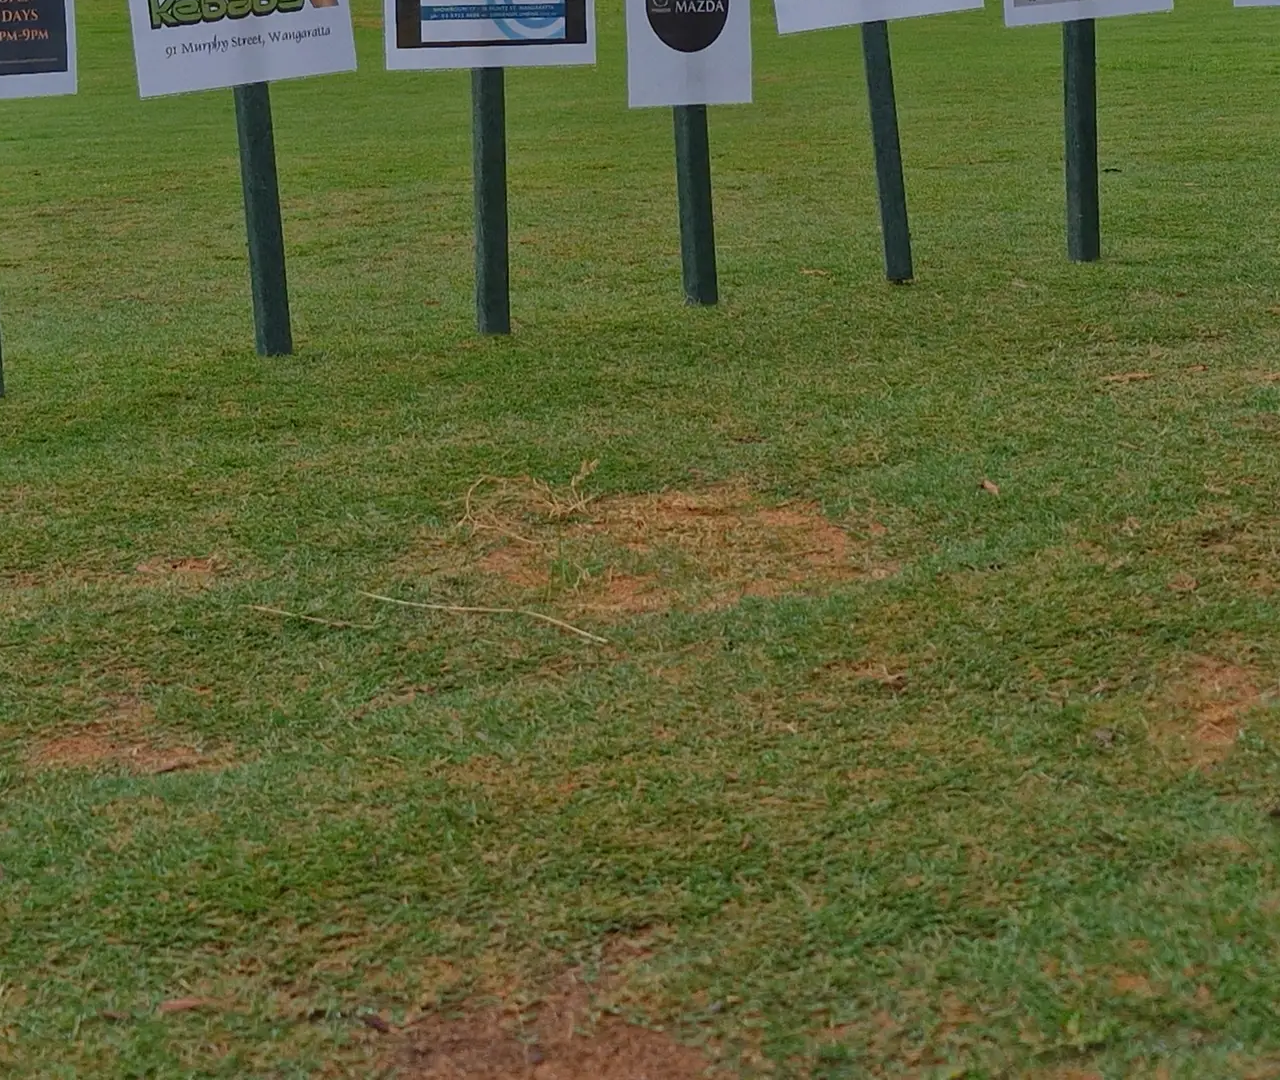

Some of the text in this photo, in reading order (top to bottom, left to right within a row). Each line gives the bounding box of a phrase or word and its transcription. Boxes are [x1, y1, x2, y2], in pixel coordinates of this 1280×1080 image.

[675, 0, 725, 13] MAZDA
[2, 9, 39, 22] DAYS
[165, 26, 331, 59] 91 Murphy Street, Wangaratta
